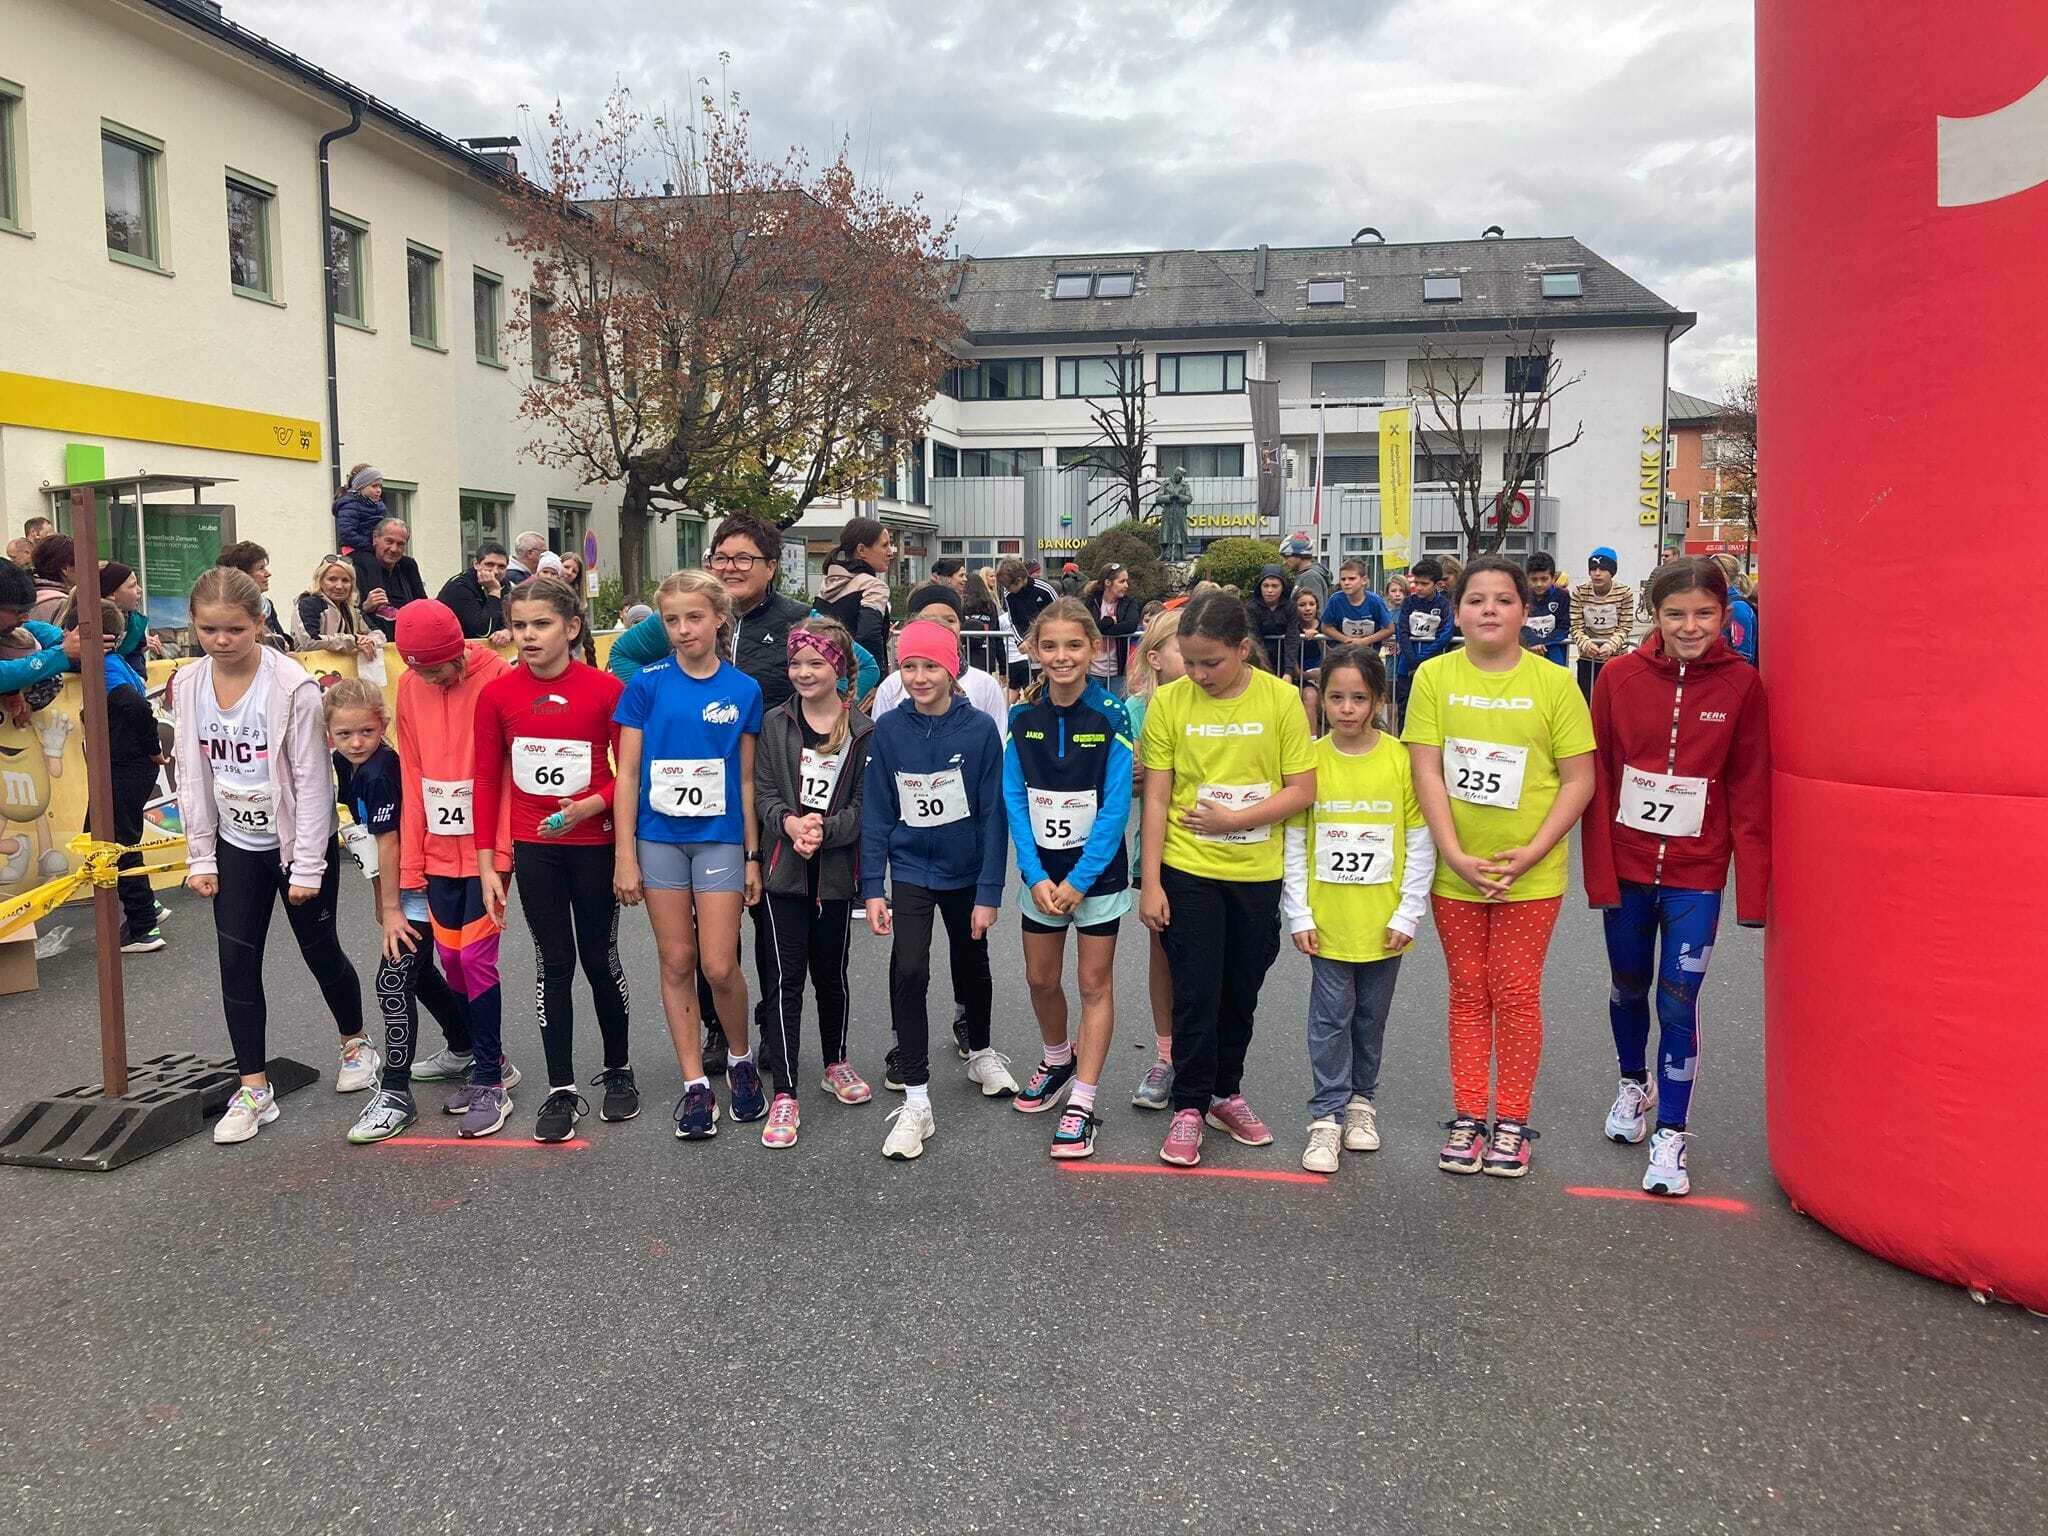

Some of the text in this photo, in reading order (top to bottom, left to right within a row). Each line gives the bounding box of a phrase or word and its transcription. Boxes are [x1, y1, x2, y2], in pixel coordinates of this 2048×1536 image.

[300, 437, 310, 450] 99
[1639, 450, 1660, 526] BANK
[1593, 616, 1606, 625] 22
[1448, 693, 1534, 711] HEAD
[1025, 730, 1044, 740] JAKO
[1185, 722, 1264, 737] HEAD
[535, 766, 565, 786] 66
[1457, 768, 1502, 793] 235
[674, 787, 703, 806] 70
[438, 807, 465, 825] 24
[916, 799, 944, 817] 30
[1314, 800, 1393, 813] HEAD
[1641, 801, 1675, 823] 27
[228, 807, 269, 827] 243
[1045, 819, 1072, 839] 55
[1331, 852, 1375, 872] 237
[536, 981, 548, 1028] TOKYO
